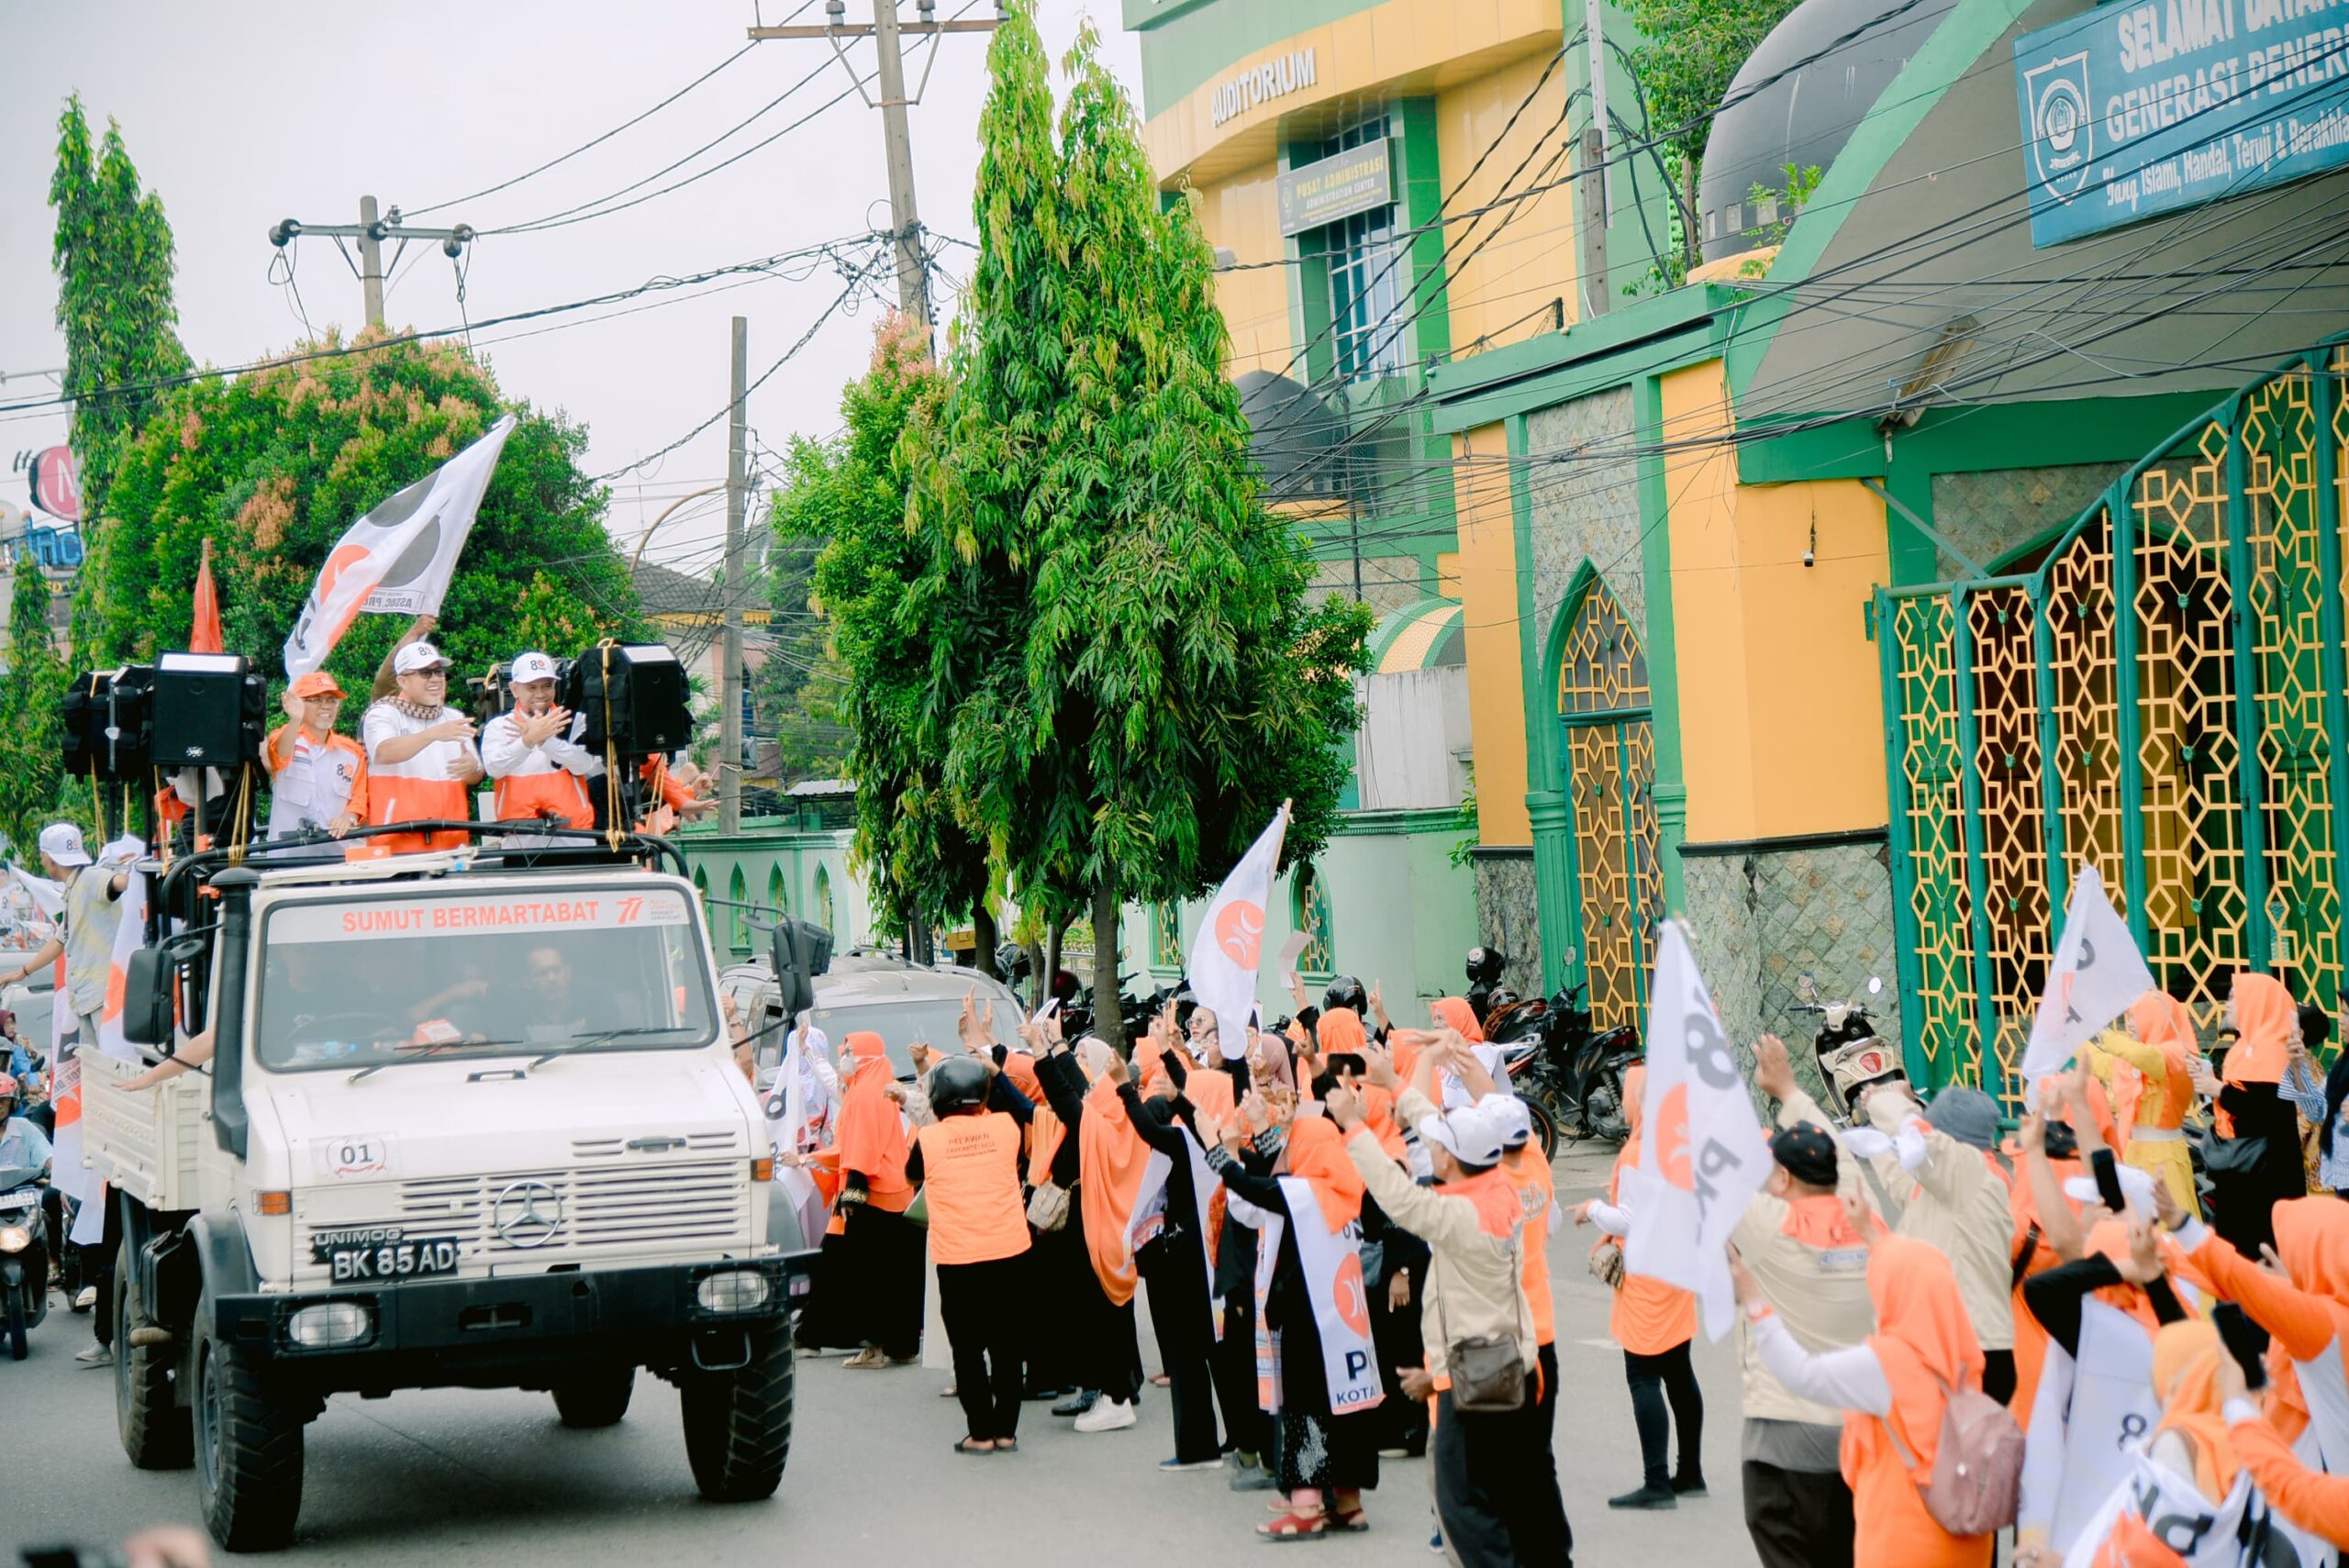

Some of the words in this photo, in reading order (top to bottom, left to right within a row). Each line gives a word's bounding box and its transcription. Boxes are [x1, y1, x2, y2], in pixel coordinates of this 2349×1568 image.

[2118, 0, 2235, 73] SELAMAT
[1212, 47, 1318, 128] AUDITORIUM
[2106, 56, 2243, 143] GENERASI
[2248, 23, 2349, 100] PENER
[2182, 138, 2232, 181] Handal,
[2232, 126, 2272, 173] Teruji
[2275, 121, 2288, 160] &
[1296, 176, 1321, 199] PUSAT
[1323, 155, 1384, 190] ADMINISTRASI
[530, 660, 539, 671] 8
[342, 909, 424, 933] SUMUT
[432, 900, 600, 929] BERMARTABAT
[340, 1144, 373, 1165] 01
[315, 1229, 401, 1246] UNIMOG
[333, 1249, 372, 1280] BK
[377, 1245, 415, 1275] 85
[418, 1241, 454, 1273] AD
